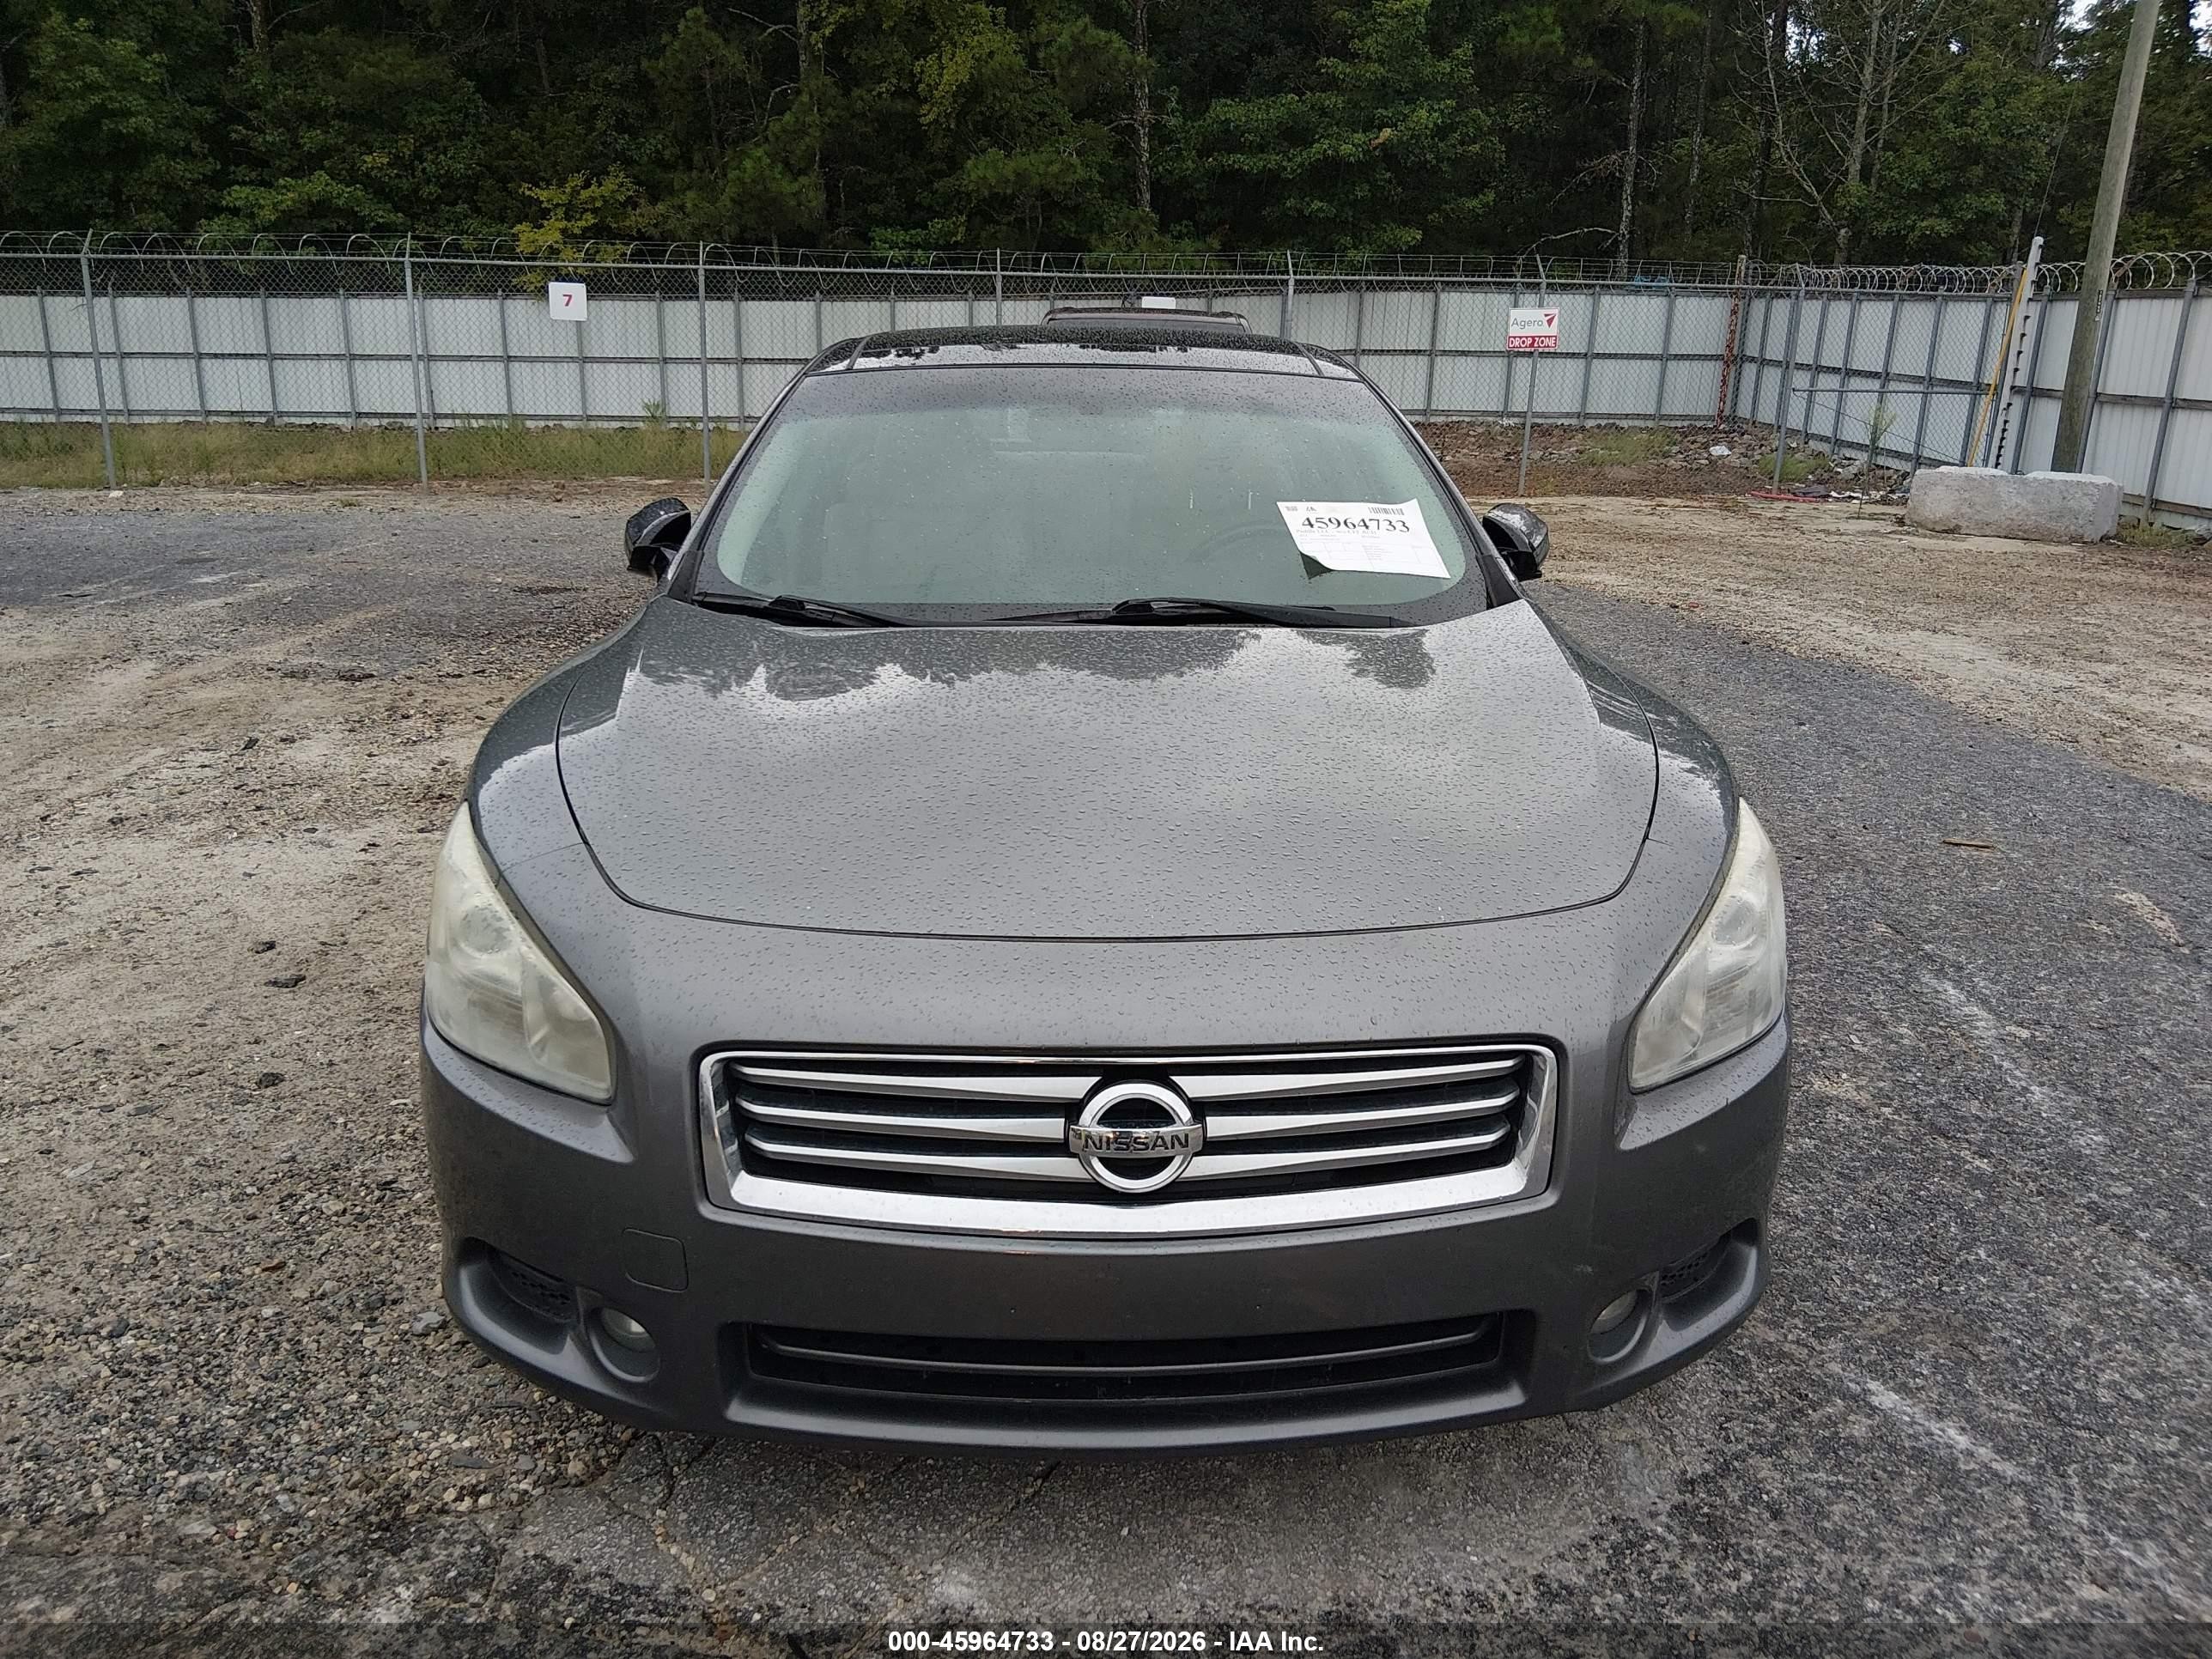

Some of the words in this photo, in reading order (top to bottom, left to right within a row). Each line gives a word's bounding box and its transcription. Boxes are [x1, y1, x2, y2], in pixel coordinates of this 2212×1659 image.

[562, 294, 573, 307] 7
[1511, 317, 1544, 330] Agero
[1509, 337, 1533, 347] DROP
[1534, 337, 1556, 347] ZONE
[1302, 517, 1410, 533] 45964733
[1082, 1133, 1189, 1152] NISSAN
